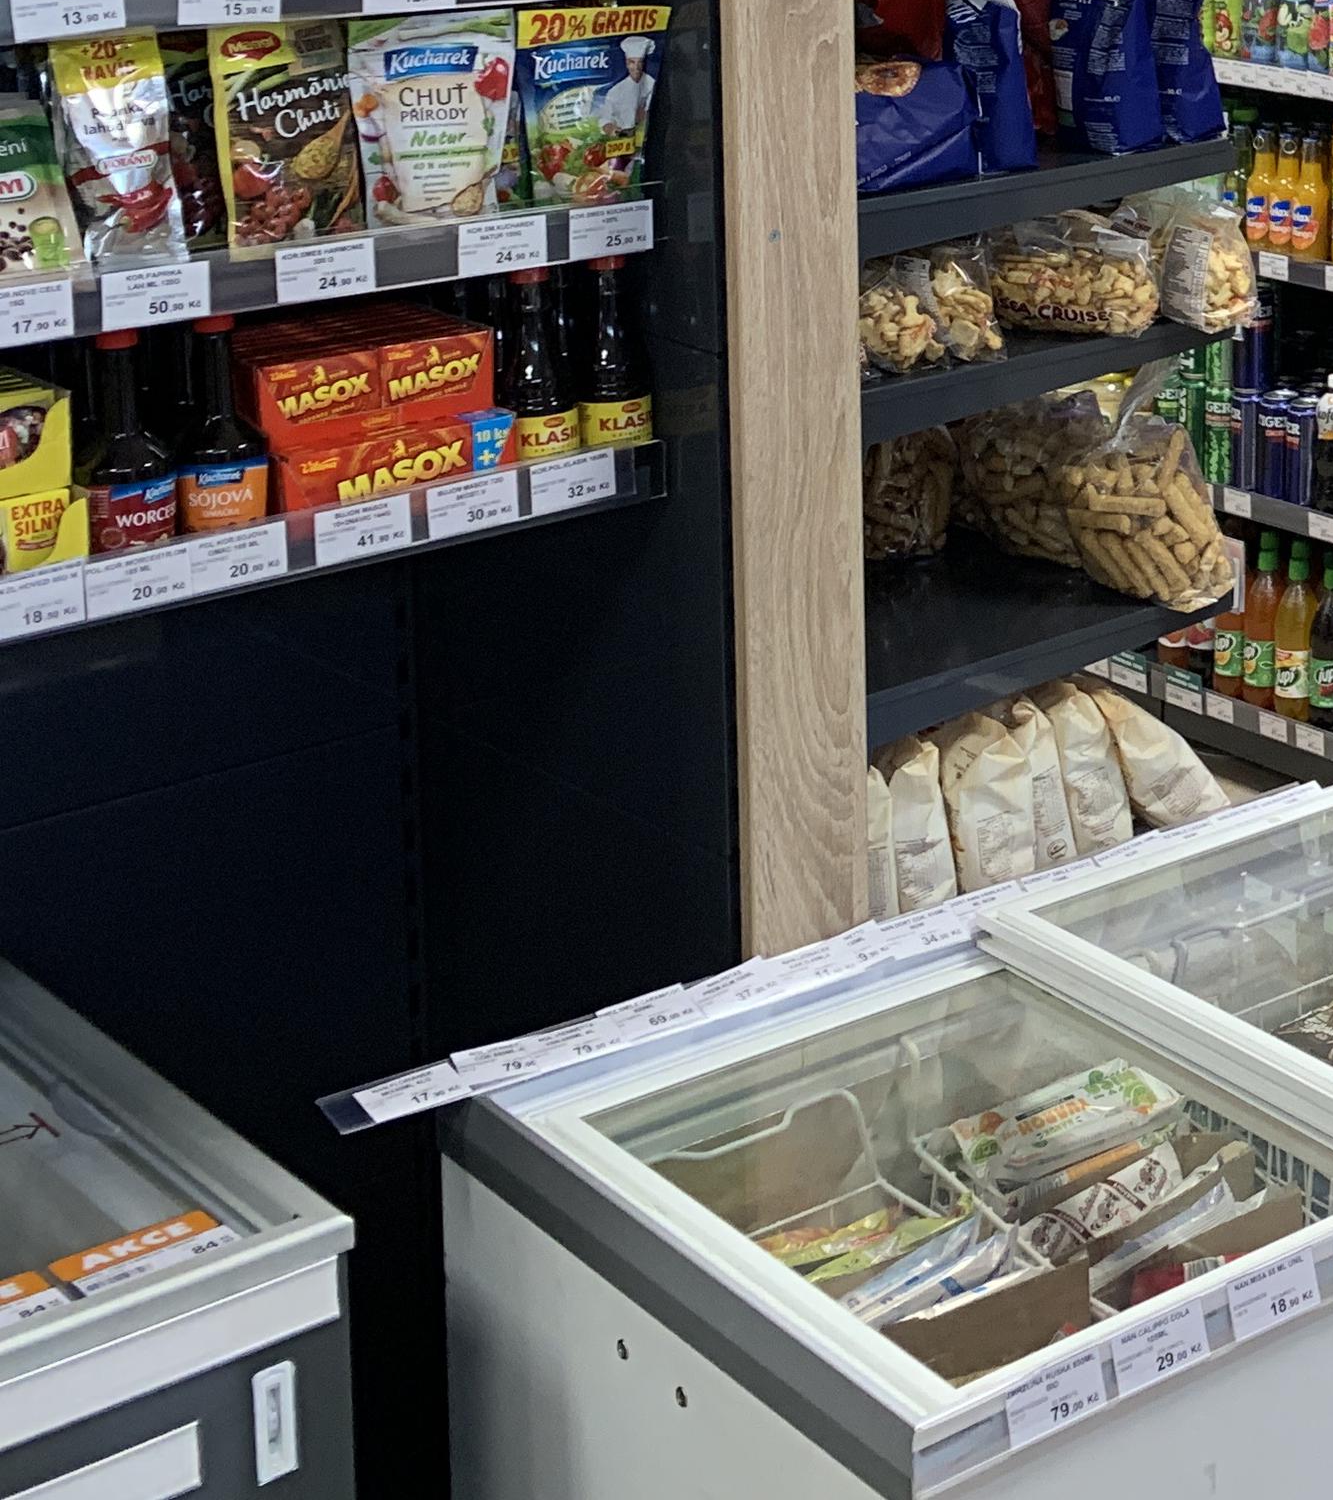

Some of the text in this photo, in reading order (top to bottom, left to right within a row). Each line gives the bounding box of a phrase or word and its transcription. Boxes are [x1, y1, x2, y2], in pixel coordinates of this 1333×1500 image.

[591, 8, 657, 36] GRATIS
[390, 48, 470, 75] Kucharek
[534, 53, 609, 80] Kucharek
[399, 83, 468, 106] CHUŤ
[400, 106, 468, 123] PŘÍRODY
[410, 131, 465, 148] Natur
[388, 352, 481, 402] MASOX
[277, 371, 372, 421] MASOX
[336, 440, 467, 502] MASOX
[188, 484, 253, 508] SÓJOVÁ
[11, 499, 65, 522] EXTRA
[81, 1220, 193, 1272] AKCE
